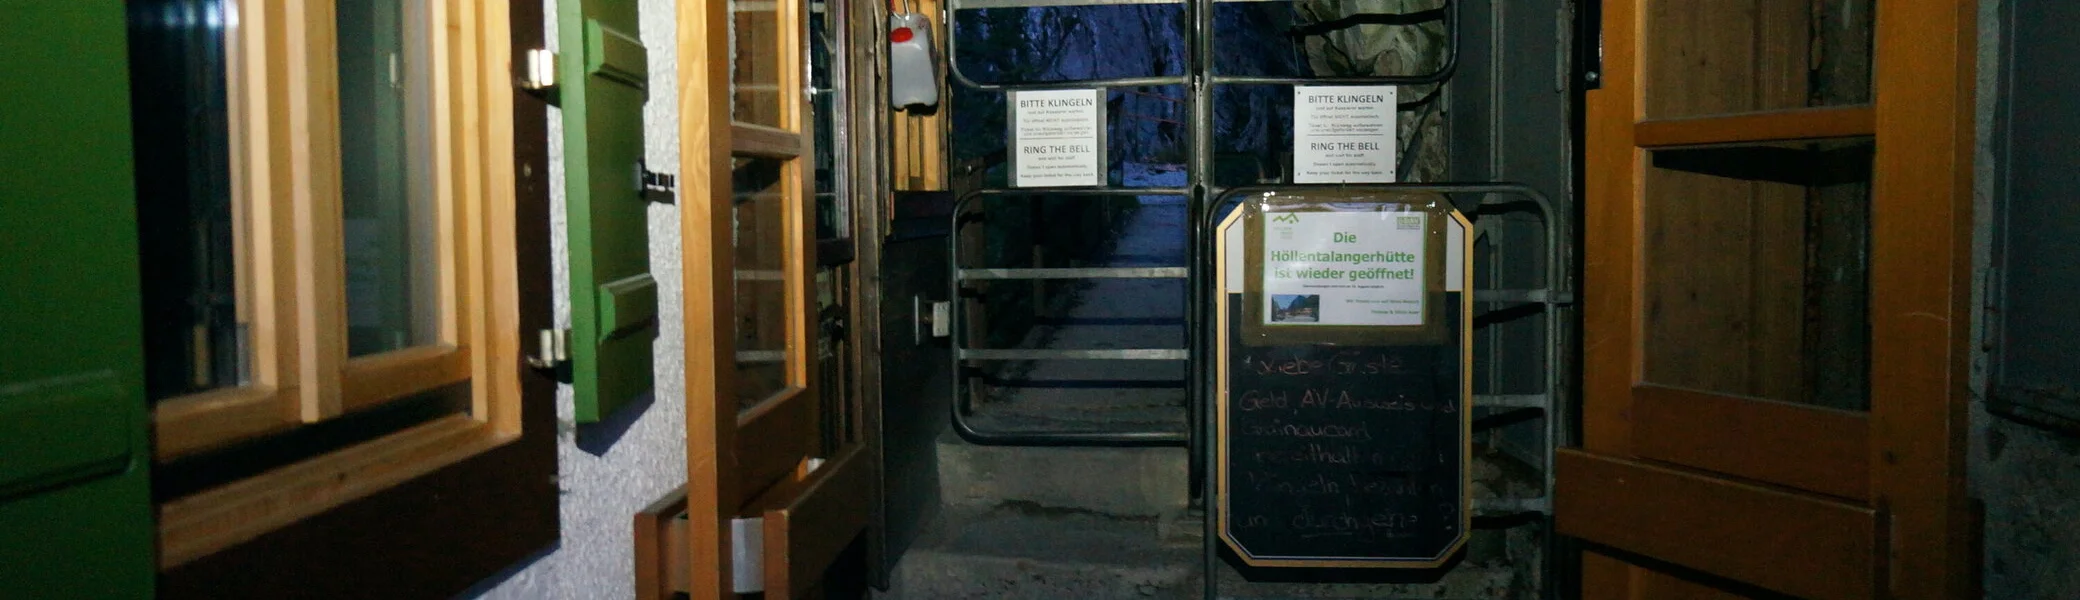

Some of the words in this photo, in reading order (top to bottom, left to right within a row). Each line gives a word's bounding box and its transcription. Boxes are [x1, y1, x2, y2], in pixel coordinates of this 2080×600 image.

[1020, 99, 1045, 108] BITTE
[1048, 98, 1093, 107] KLINGELN
[1308, 95, 1334, 103] BITTE
[1337, 94, 1384, 103] KLINGELN
[1023, 146, 1047, 154] RING
[1049, 145, 1067, 153] THE
[1069, 145, 1091, 153] BELL
[1311, 142, 1335, 151] RING
[1337, 142, 1357, 151] THE
[1358, 142, 1380, 151] BELL
[1333, 231, 1357, 244] Die
[1271, 250, 1415, 265] Höllentalangerhütte
[1274, 267, 1292, 279] ist
[1296, 267, 1344, 280] wieder
[1348, 267, 1415, 281] geöffnet!
